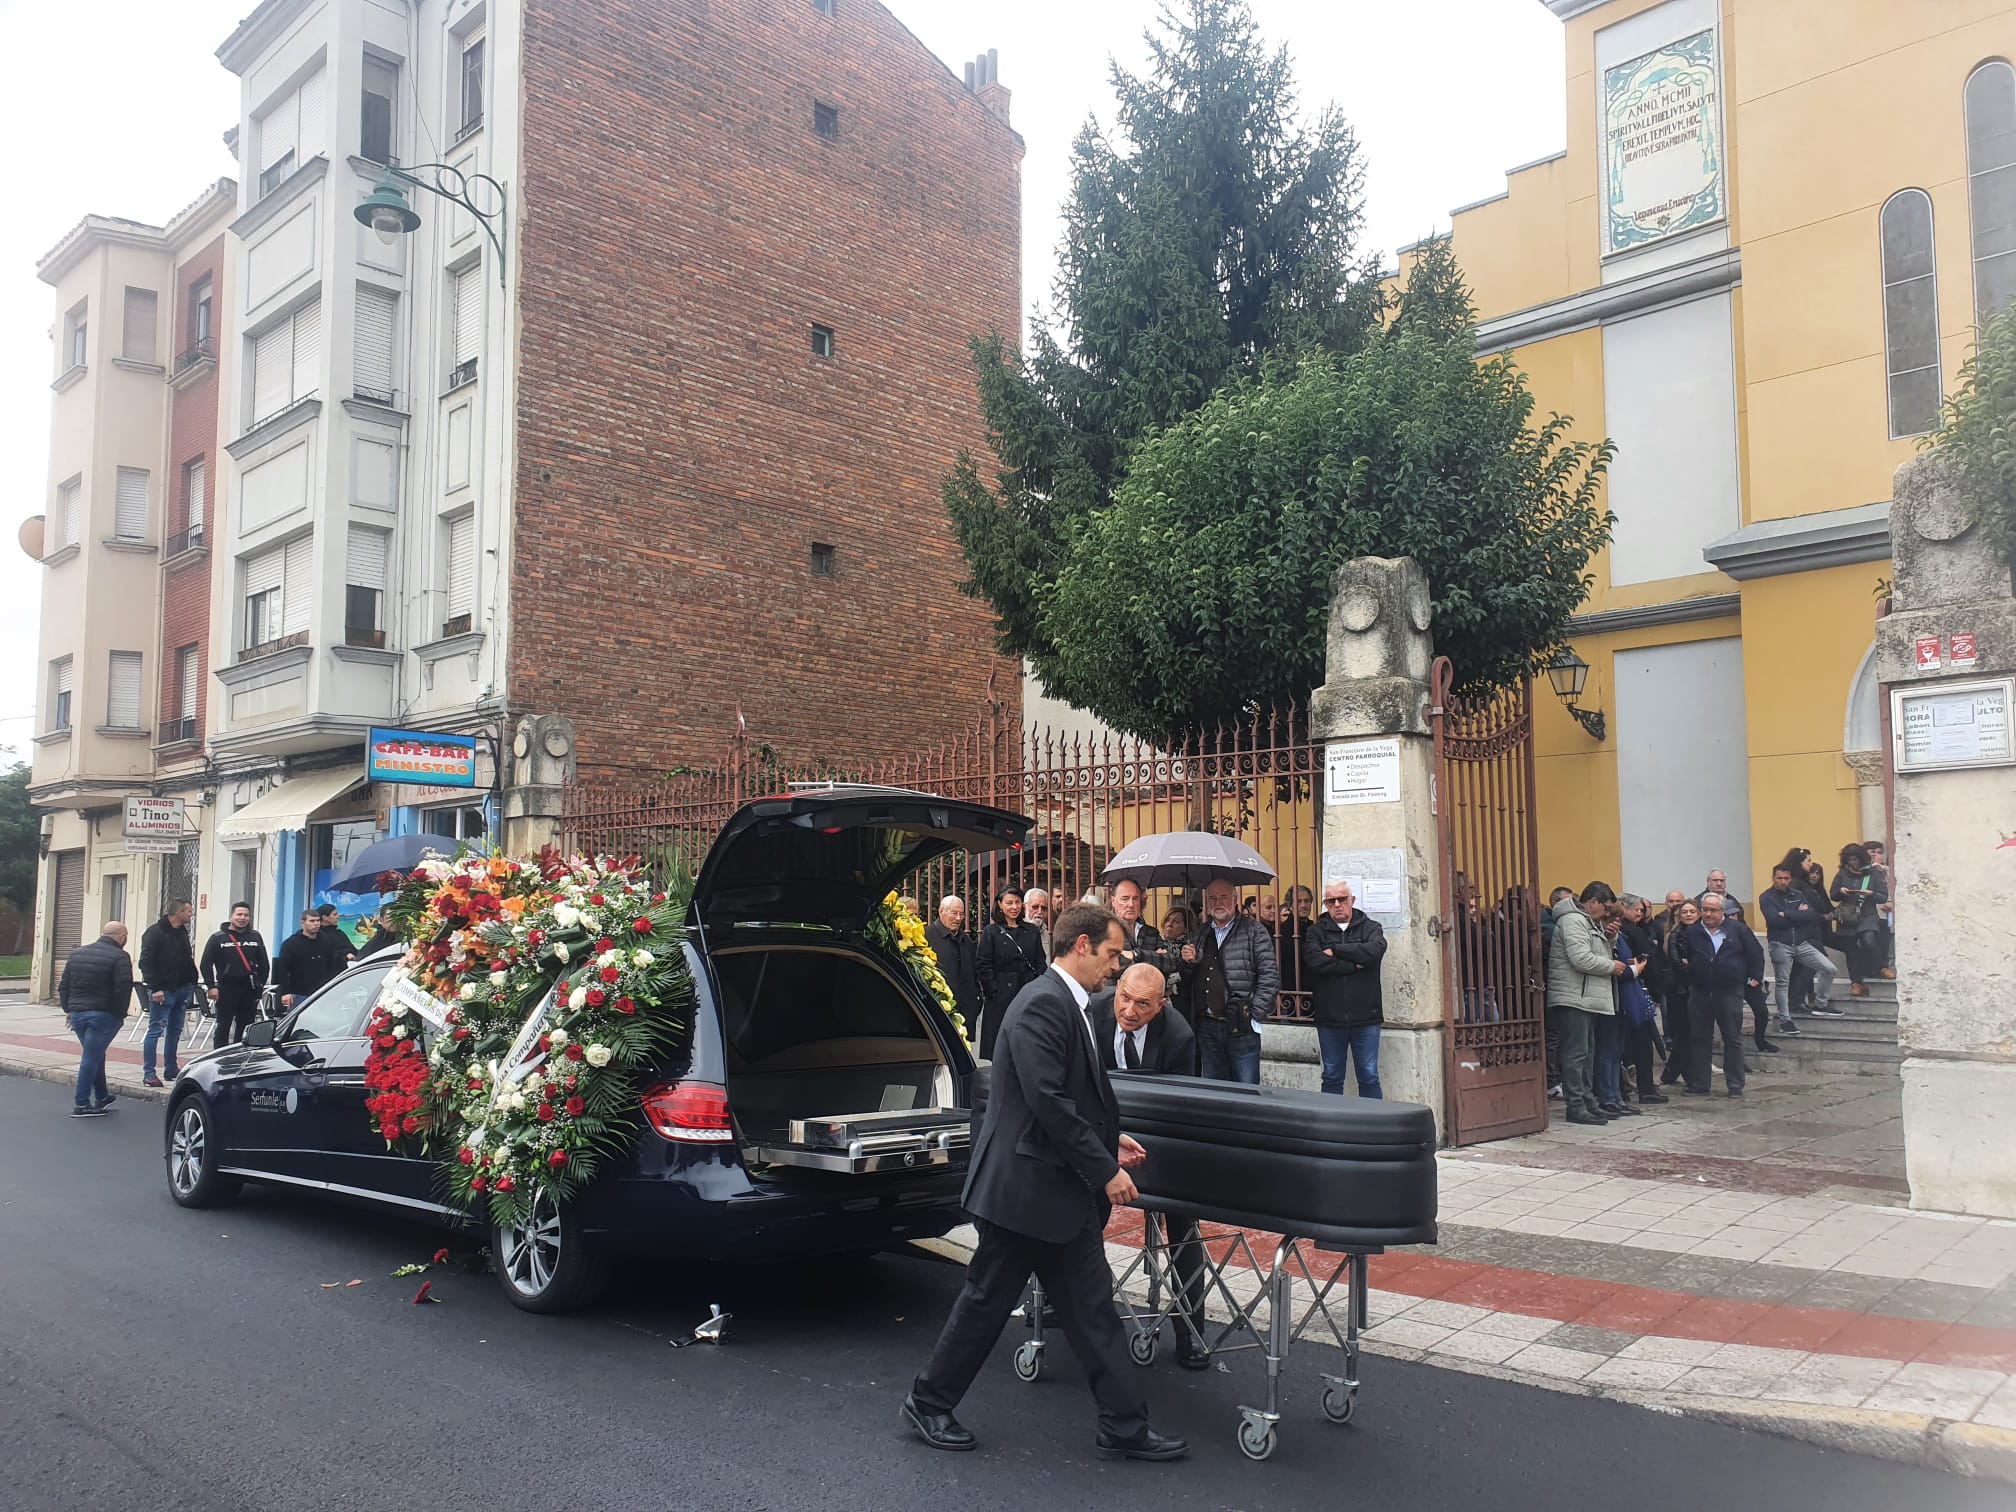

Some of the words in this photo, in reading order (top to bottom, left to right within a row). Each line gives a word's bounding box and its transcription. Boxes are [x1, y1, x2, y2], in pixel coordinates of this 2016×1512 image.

[1661, 86, 1691, 107] MCMII
[1355, 751, 1397, 760] PARROQUIAL
[375, 758, 470, 776] MINISTRO
[138, 800, 175, 808] VIDRIOS
[141, 808, 170, 821] Tino
[128, 822, 181, 830] ALUMINIOS
